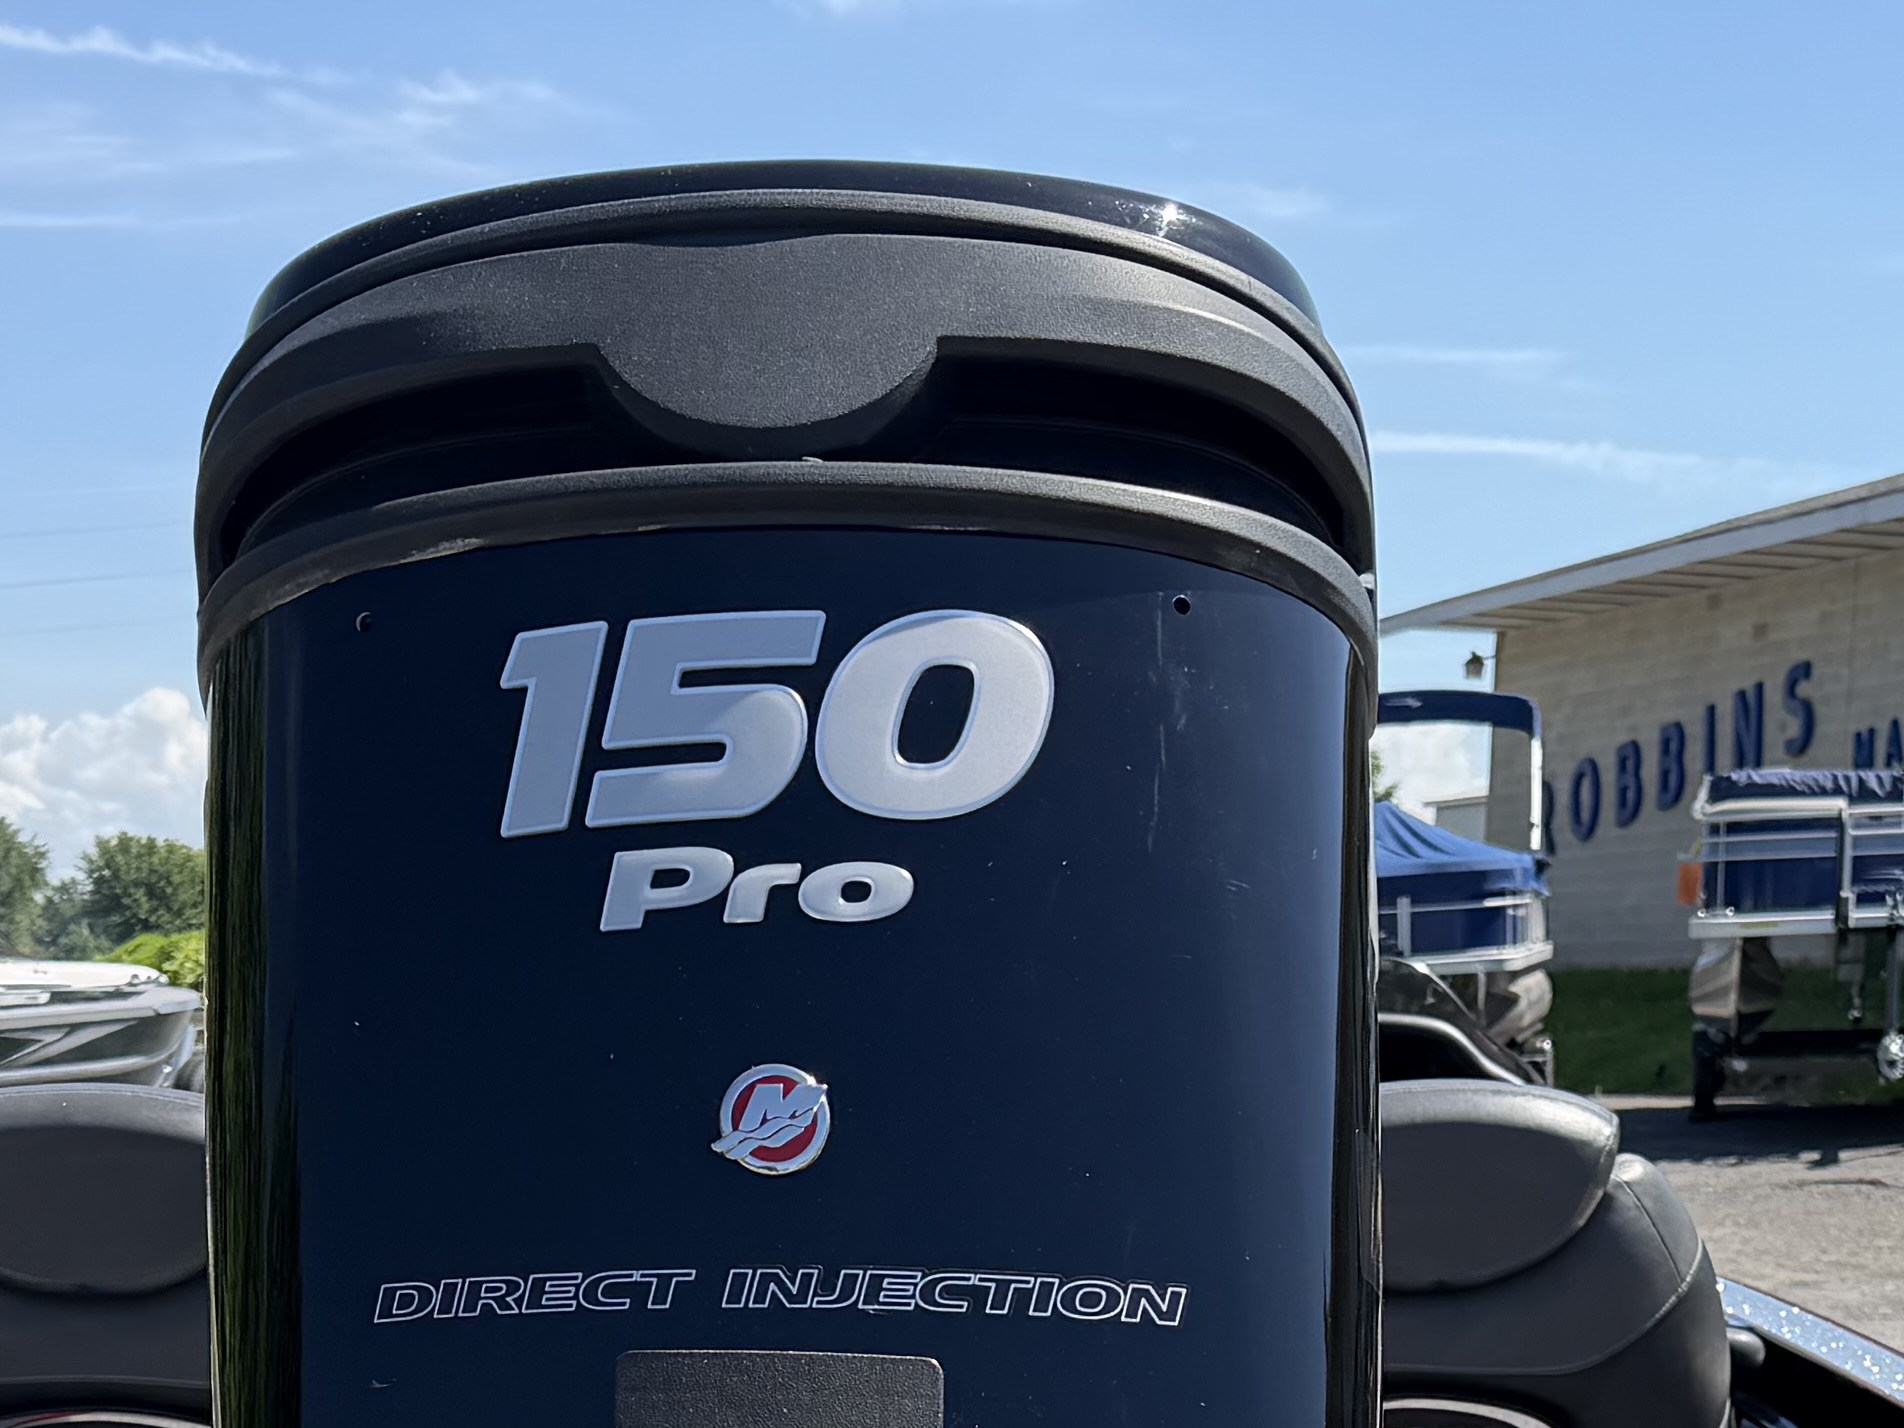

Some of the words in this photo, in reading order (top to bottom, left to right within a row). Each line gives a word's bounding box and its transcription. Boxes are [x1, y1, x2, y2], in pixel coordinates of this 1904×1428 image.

[500, 609, 1054, 837] 150
[599, 847, 915, 931] Pro
[374, 1269, 694, 1324] DIRECT
[721, 1265, 1187, 1327] INJECTION
